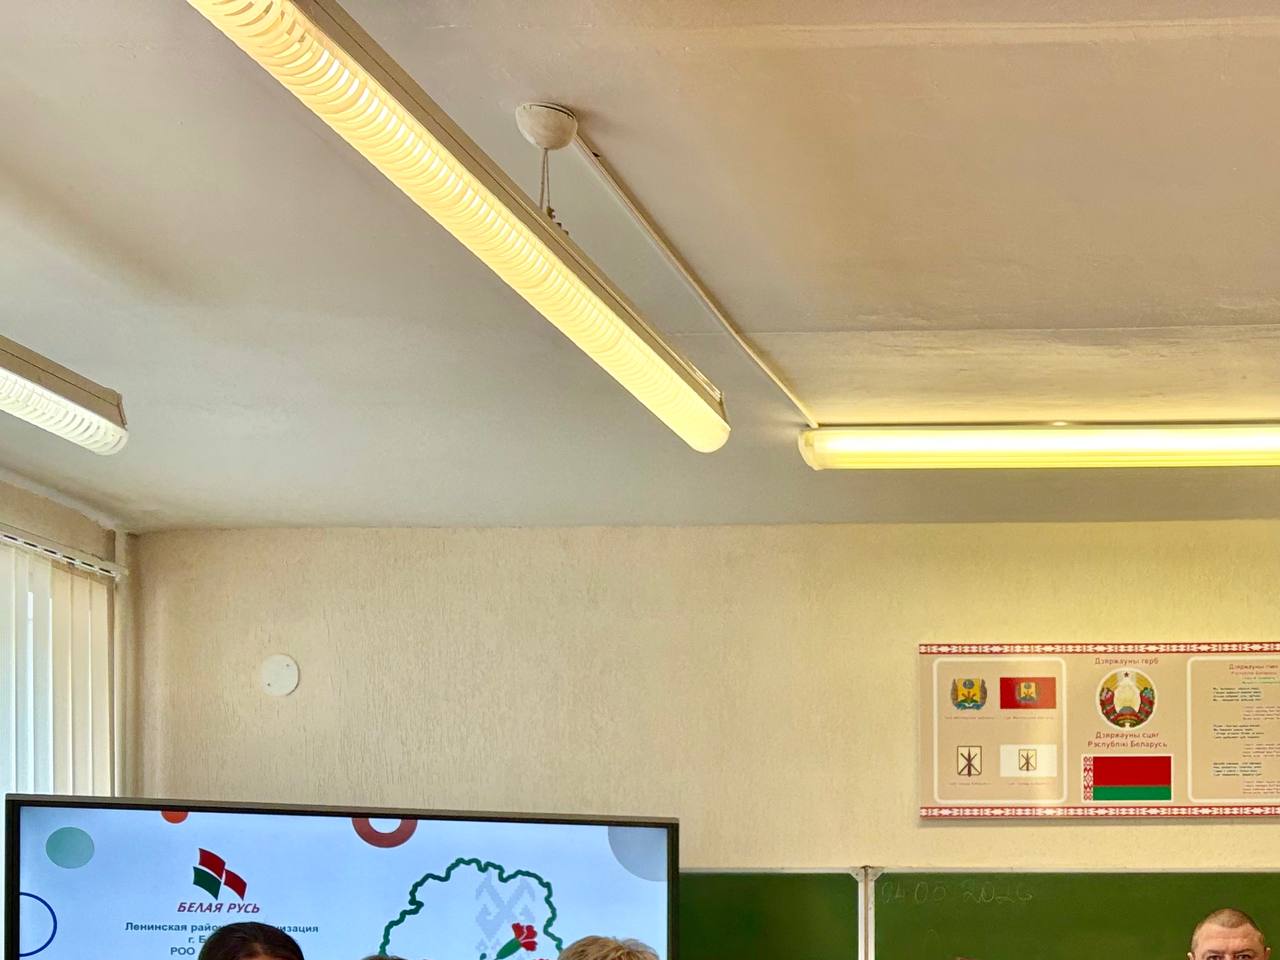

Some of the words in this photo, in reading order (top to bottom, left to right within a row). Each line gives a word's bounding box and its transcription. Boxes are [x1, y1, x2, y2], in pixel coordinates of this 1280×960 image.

[177, 902, 223, 913] БЕЛАЯ
[226, 902, 260, 914] РУСЬ
[125, 922, 187, 932] Ленинская
[190, 922, 223, 934] райо
[170, 946, 195, 956] РОО
